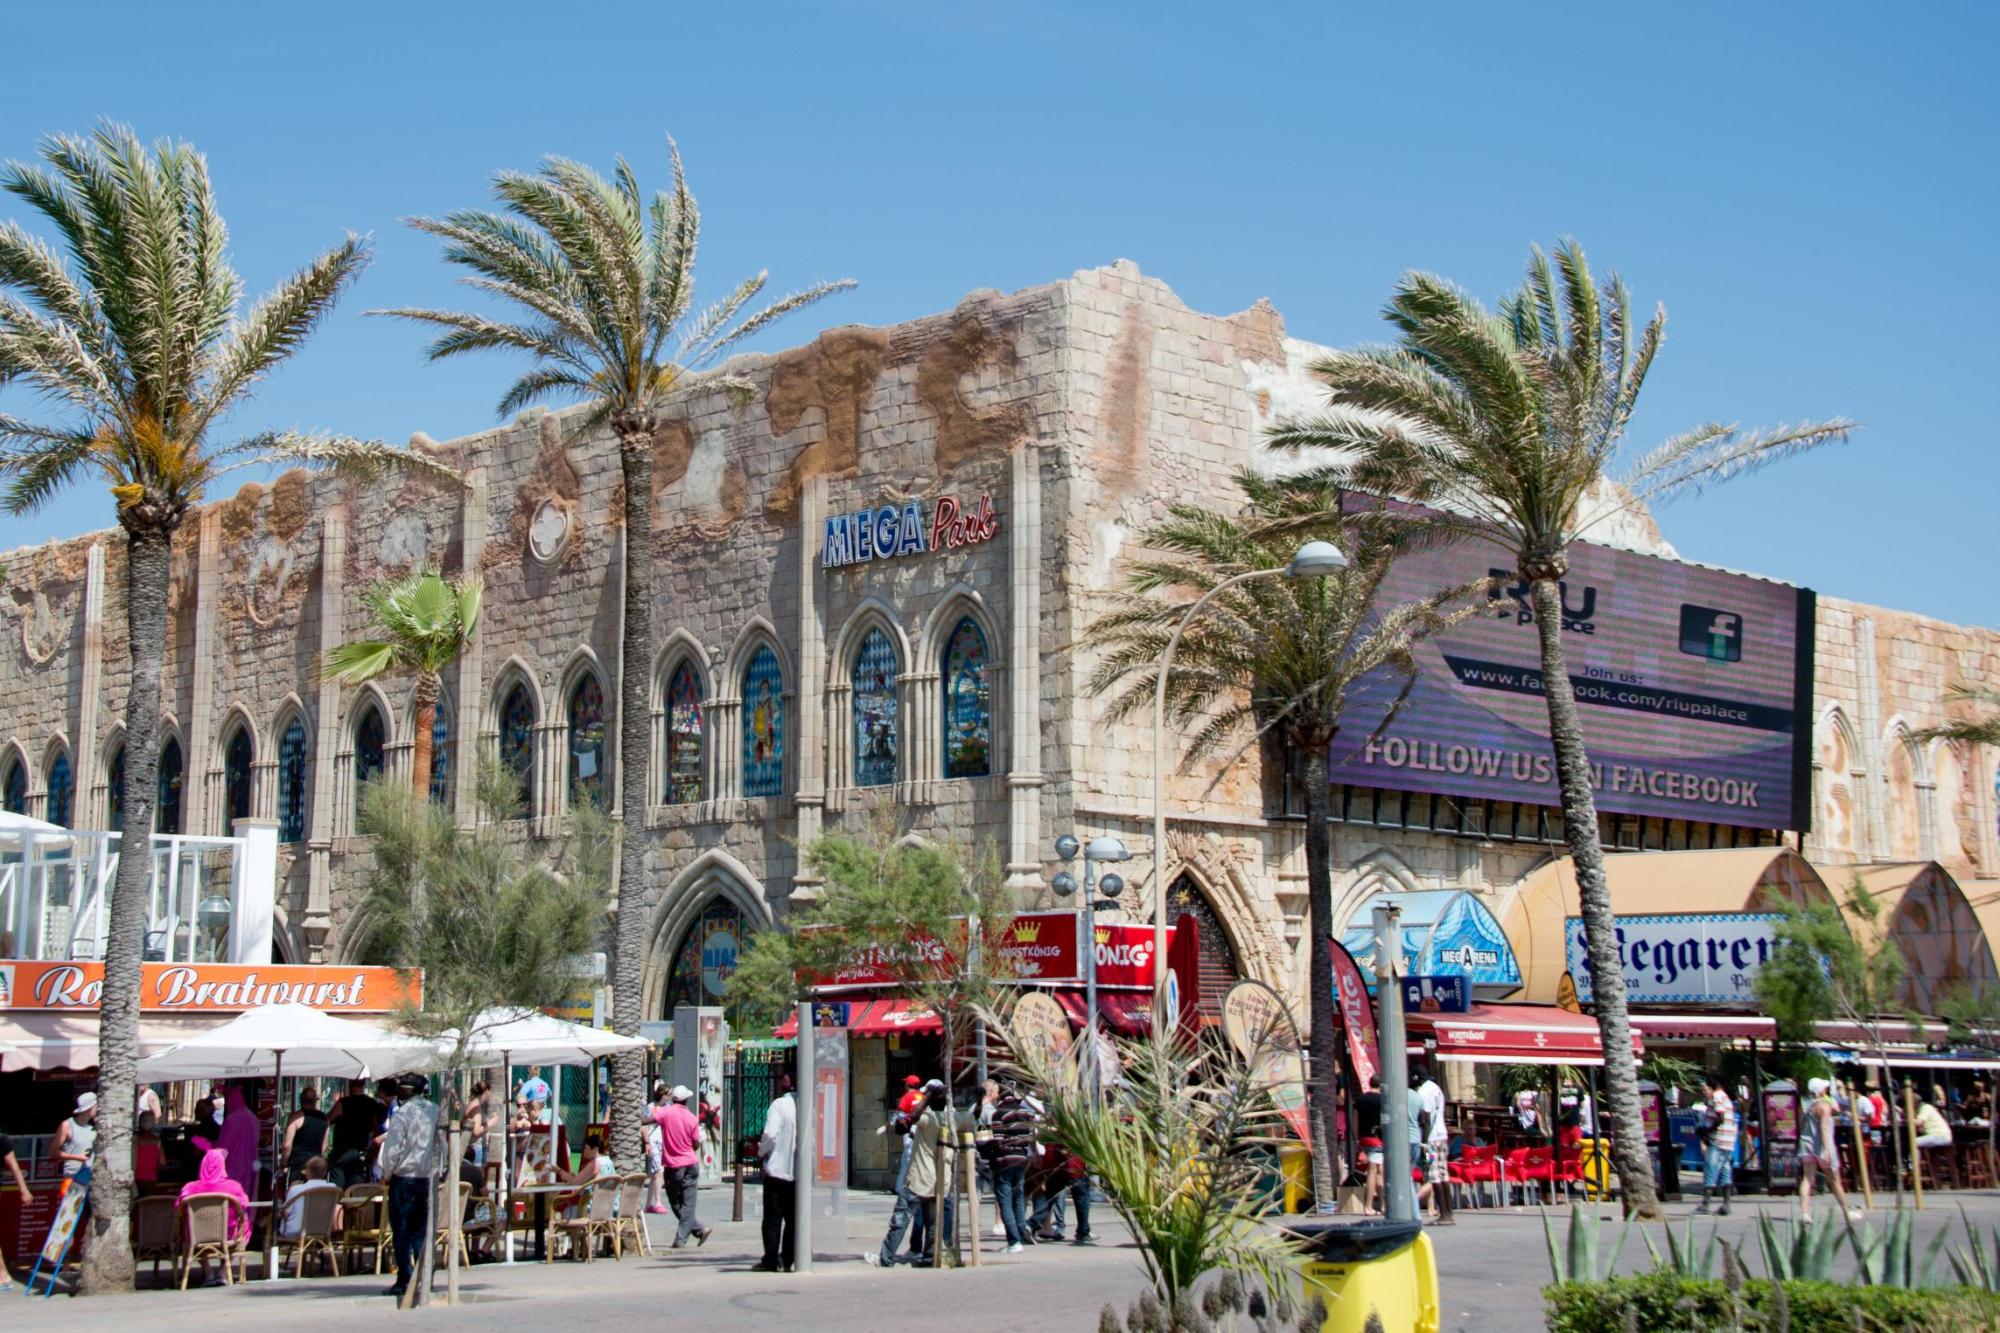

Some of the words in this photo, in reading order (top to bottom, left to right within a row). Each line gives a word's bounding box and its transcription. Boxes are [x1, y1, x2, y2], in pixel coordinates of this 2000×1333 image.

[822, 500, 925, 568] MEGA
[929, 491, 999, 552] Park
[1488, 567, 1597, 621] RU
[1463, 666, 1749, 722] www.faook.com/riupalace
[1583, 665, 1615, 682] Join
[1620, 672, 1644, 684] us:
[1364, 735, 1502, 777] FOLLOW
[1511, 752, 1552, 784] US
[1611, 765, 1760, 808] FACEBOOK
[156, 967, 367, 1008] Bratwurst
